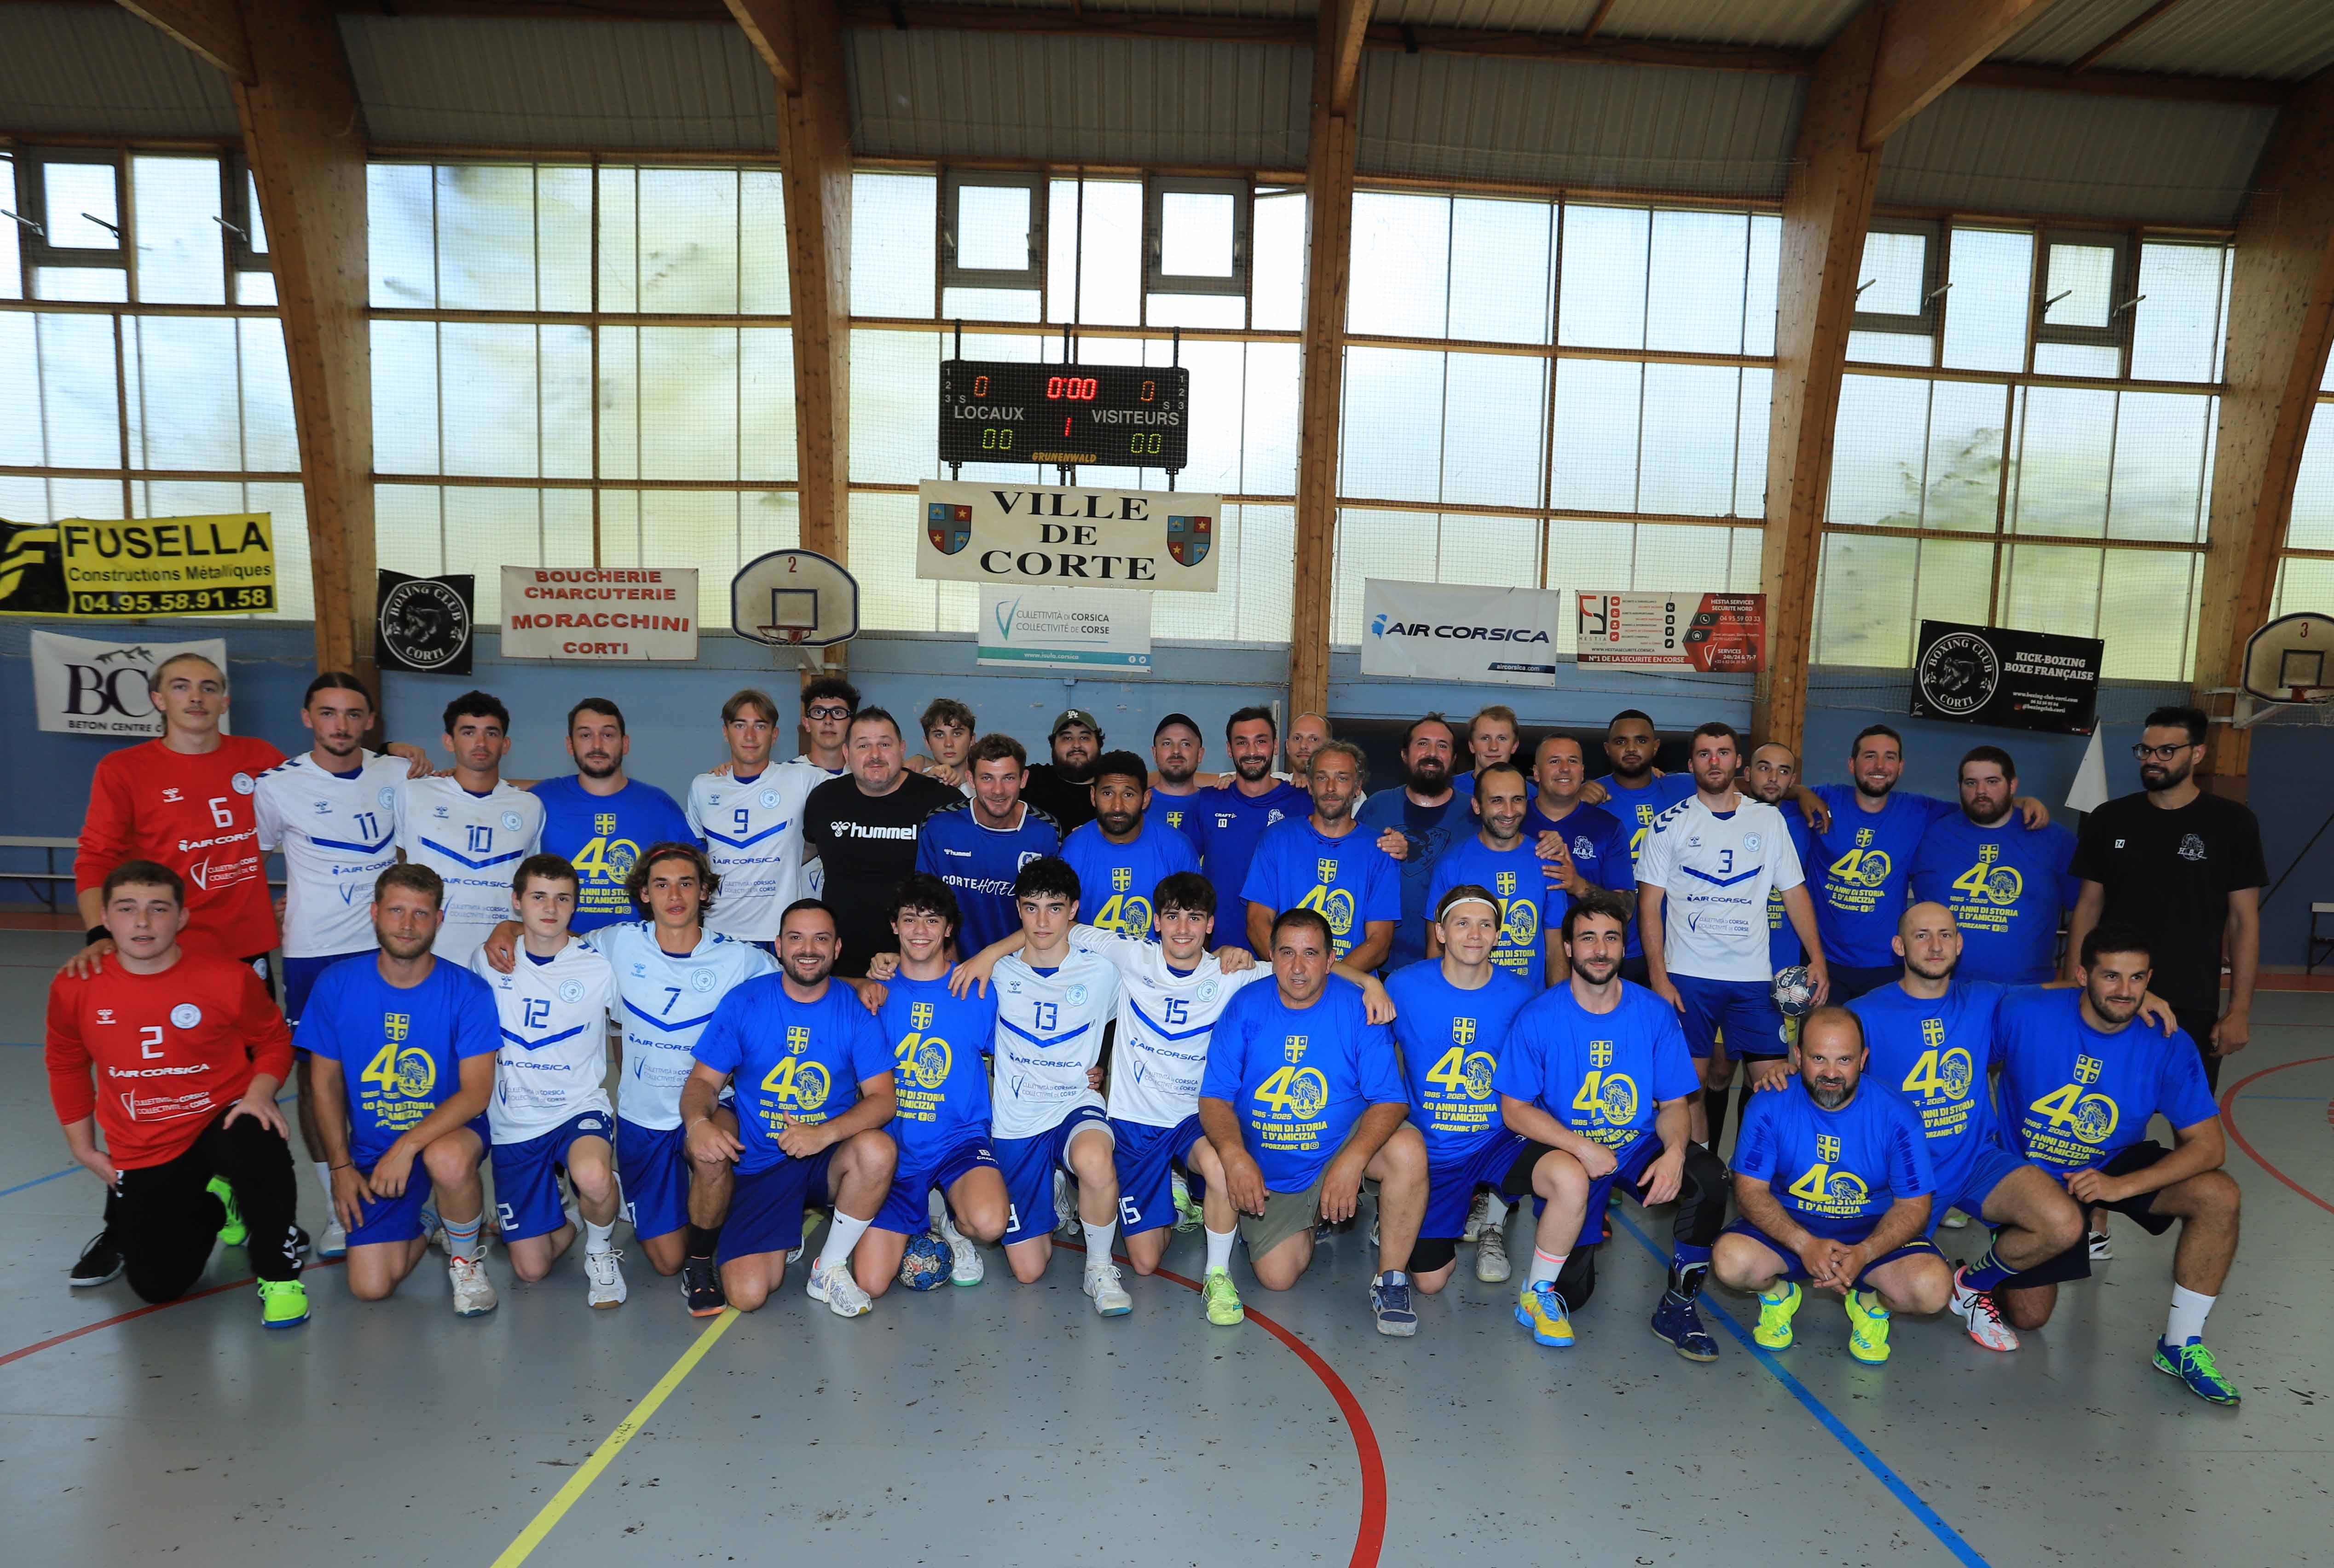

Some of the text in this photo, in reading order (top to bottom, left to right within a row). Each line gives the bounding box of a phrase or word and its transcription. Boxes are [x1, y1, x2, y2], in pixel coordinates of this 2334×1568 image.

[974, 375, 989, 397] 0
[1046, 376, 1097, 400] 0:00
[1141, 380, 1155, 401] 0
[954, 406, 1024, 421] LOCAUX
[1163, 402, 1170, 410] S
[1092, 409, 1179, 425] VISITEURS
[990, 490, 1149, 521] VILLE
[64, 521, 270, 559] FUSELLA
[1039, 524, 1098, 546] DE
[69, 564, 272, 582] Constructions Métalliques
[788, 556, 797, 573] 2
[980, 550, 1156, 581] CORTE
[535, 571, 662, 583] BOUCHERIE
[79, 589, 267, 613] 04.95.58.91.58
[524, 586, 676, 600] CHARCUTERIE
[389, 585, 462, 622] BOXING CLUB
[511, 613, 690, 632] MORACCHINI
[1017, 610, 1062, 620] CULLETTIVITÀ
[1071, 612, 1109, 622] CORSICA
[1016, 622, 1069, 633] COLLECTIVITÉ
[1081, 625, 1109, 634] CORSE
[1385, 622, 1550, 643] AIR CORSICA
[2300, 622, 2308, 638] 3
[405, 645, 445, 661] CORTI
[562, 641, 629, 654] CORTI
[1929, 638, 1993, 673] BOXING CLUB
[1496, 663, 1540, 672] aircorsica.com
[2015, 651, 2086, 668] KICK-BOXING
[2004, 663, 2094, 681] BOXE FRANÇAISE
[62, 663, 156, 717] BC
[1940, 694, 1974, 708] CORTI
[68, 720, 152, 732] BETON CENTRE
[208, 797, 234, 828] 6
[734, 809, 749, 834] 9
[353, 812, 378, 840] 11
[850, 822, 917, 840] hummel
[465, 824, 492, 853] 10
[732, 856, 780, 865] CORSICA
[1718, 849, 1733, 873] 3
[1829, 848, 1891, 888] 40
[463, 879, 514, 888] CORSICA
[1952, 862, 2023, 905] 40
[1710, 896, 1752, 905] CORSICA
[1965, 913, 2007, 923] D'AMICIZIA
[1990, 907, 2018, 917] STORIA
[1781, 967, 1800, 986] SELEC
[661, 987, 681, 1015] 7
[522, 997, 551, 1029] 12
[1033, 1001, 1058, 1031] 13
[1164, 997, 1190, 1025] 15
[139, 1026, 164, 1059] 2
[1136, 1042, 1206, 1061] AIR CORSICA
[116, 1063, 211, 1078] AIR CORSICA
[360, 1043, 436, 1098] 40
[515, 1061, 571, 1071] CORSICA
[1032, 1059, 1082, 1067] CORSICA
[1426, 1046, 1497, 1100] 40
[761, 1056, 831, 1111] 40
[1254, 1066, 1329, 1120] 40
[1424, 1090, 1440, 1099] 1985
[1252, 1109, 1266, 1118] 1985
[1423, 1102, 1497, 1113] 40 ANNI DI STORIA
[2029, 1083, 2119, 1144] 40
[1252, 1119, 1328, 1133] 40 ANNI DI STORIA
[1442, 1113, 1488, 1122] D'AMICIZIA
[1269, 1131, 1317, 1141] D'AMICIZIA
[1431, 1123, 1469, 1132] #FORZAHBC
[1261, 1142, 1298, 1150] #FORZAHBC
[1118, 1195, 1142, 1226] 15
[1805, 1202, 1861, 1214] D'AMICIZIA
